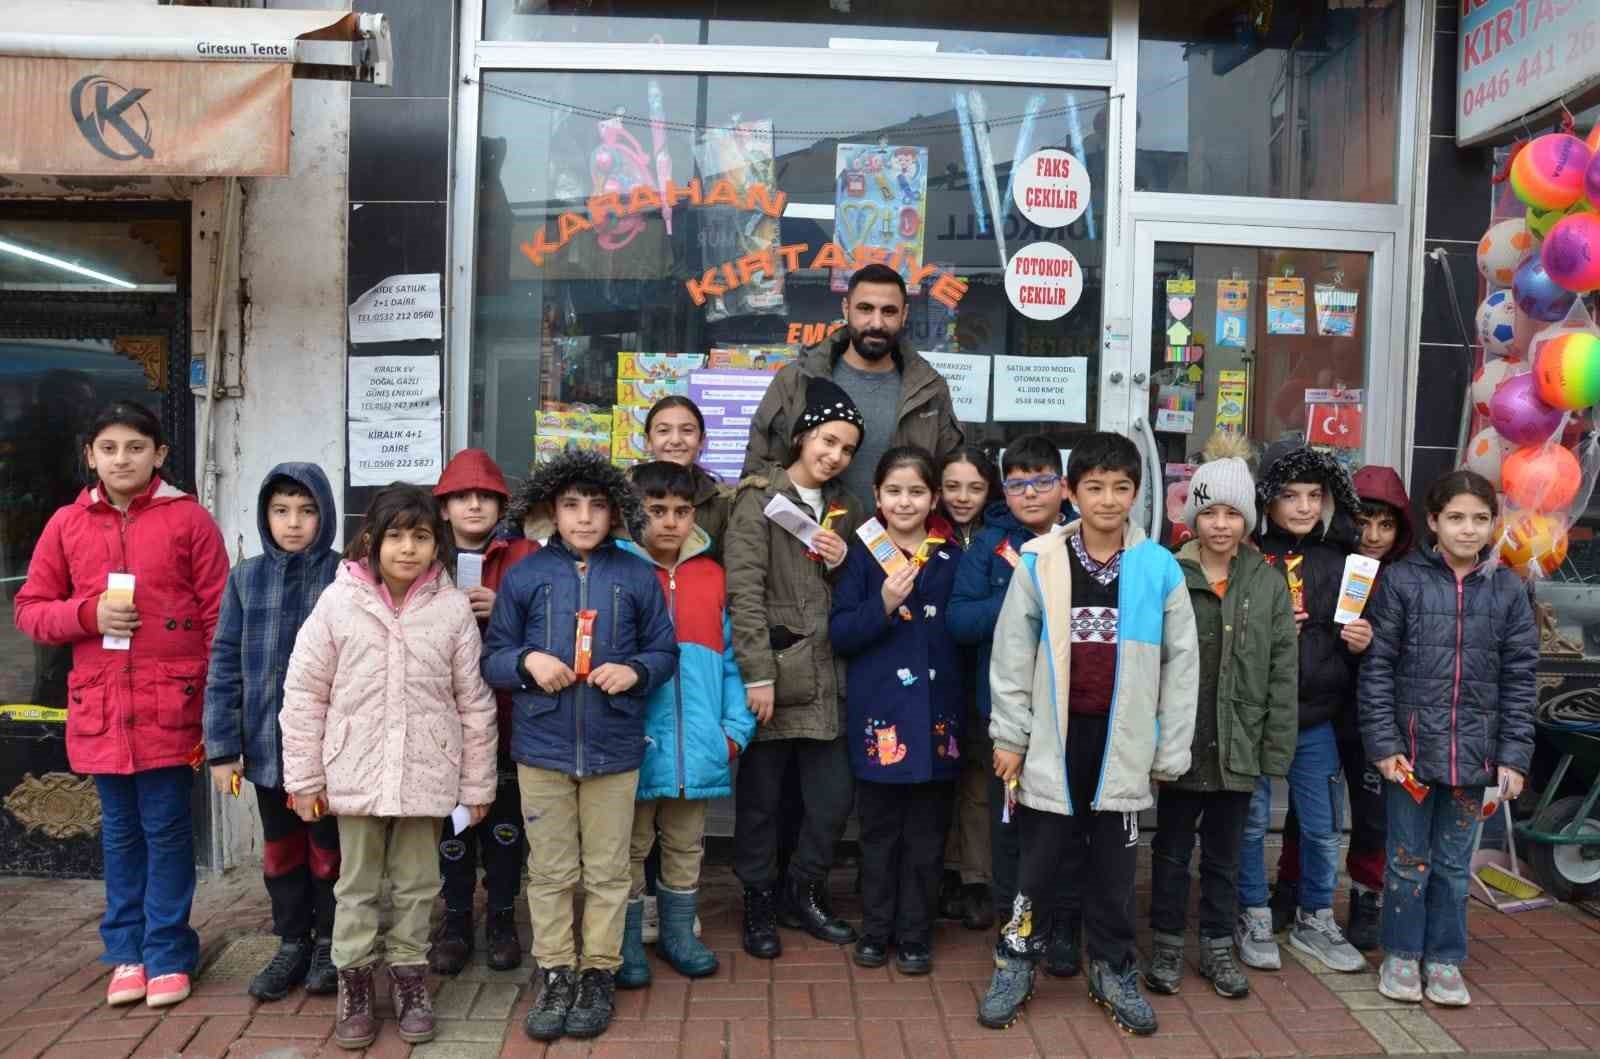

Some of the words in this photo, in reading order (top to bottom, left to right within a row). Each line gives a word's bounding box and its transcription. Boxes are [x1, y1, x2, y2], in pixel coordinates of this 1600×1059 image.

[196, 41, 246, 55] Giresun
[250, 42, 288, 56] Tente
[1463, 0, 1584, 72] KIRTA
[1463, 66, 1510, 117] 0446
[1515, 42, 1556, 88] 441
[1036, 157, 1070, 179] FAKS
[1025, 183, 1078, 213] ÇEKİLİR
[519, 176, 787, 268] KARAHAN
[1019, 281, 1067, 309] ÇEKİLİR
[1051, 366, 1076, 374] MODEL
[405, 429, 423, 439] 4+1
[396, 458, 412, 467] 222
